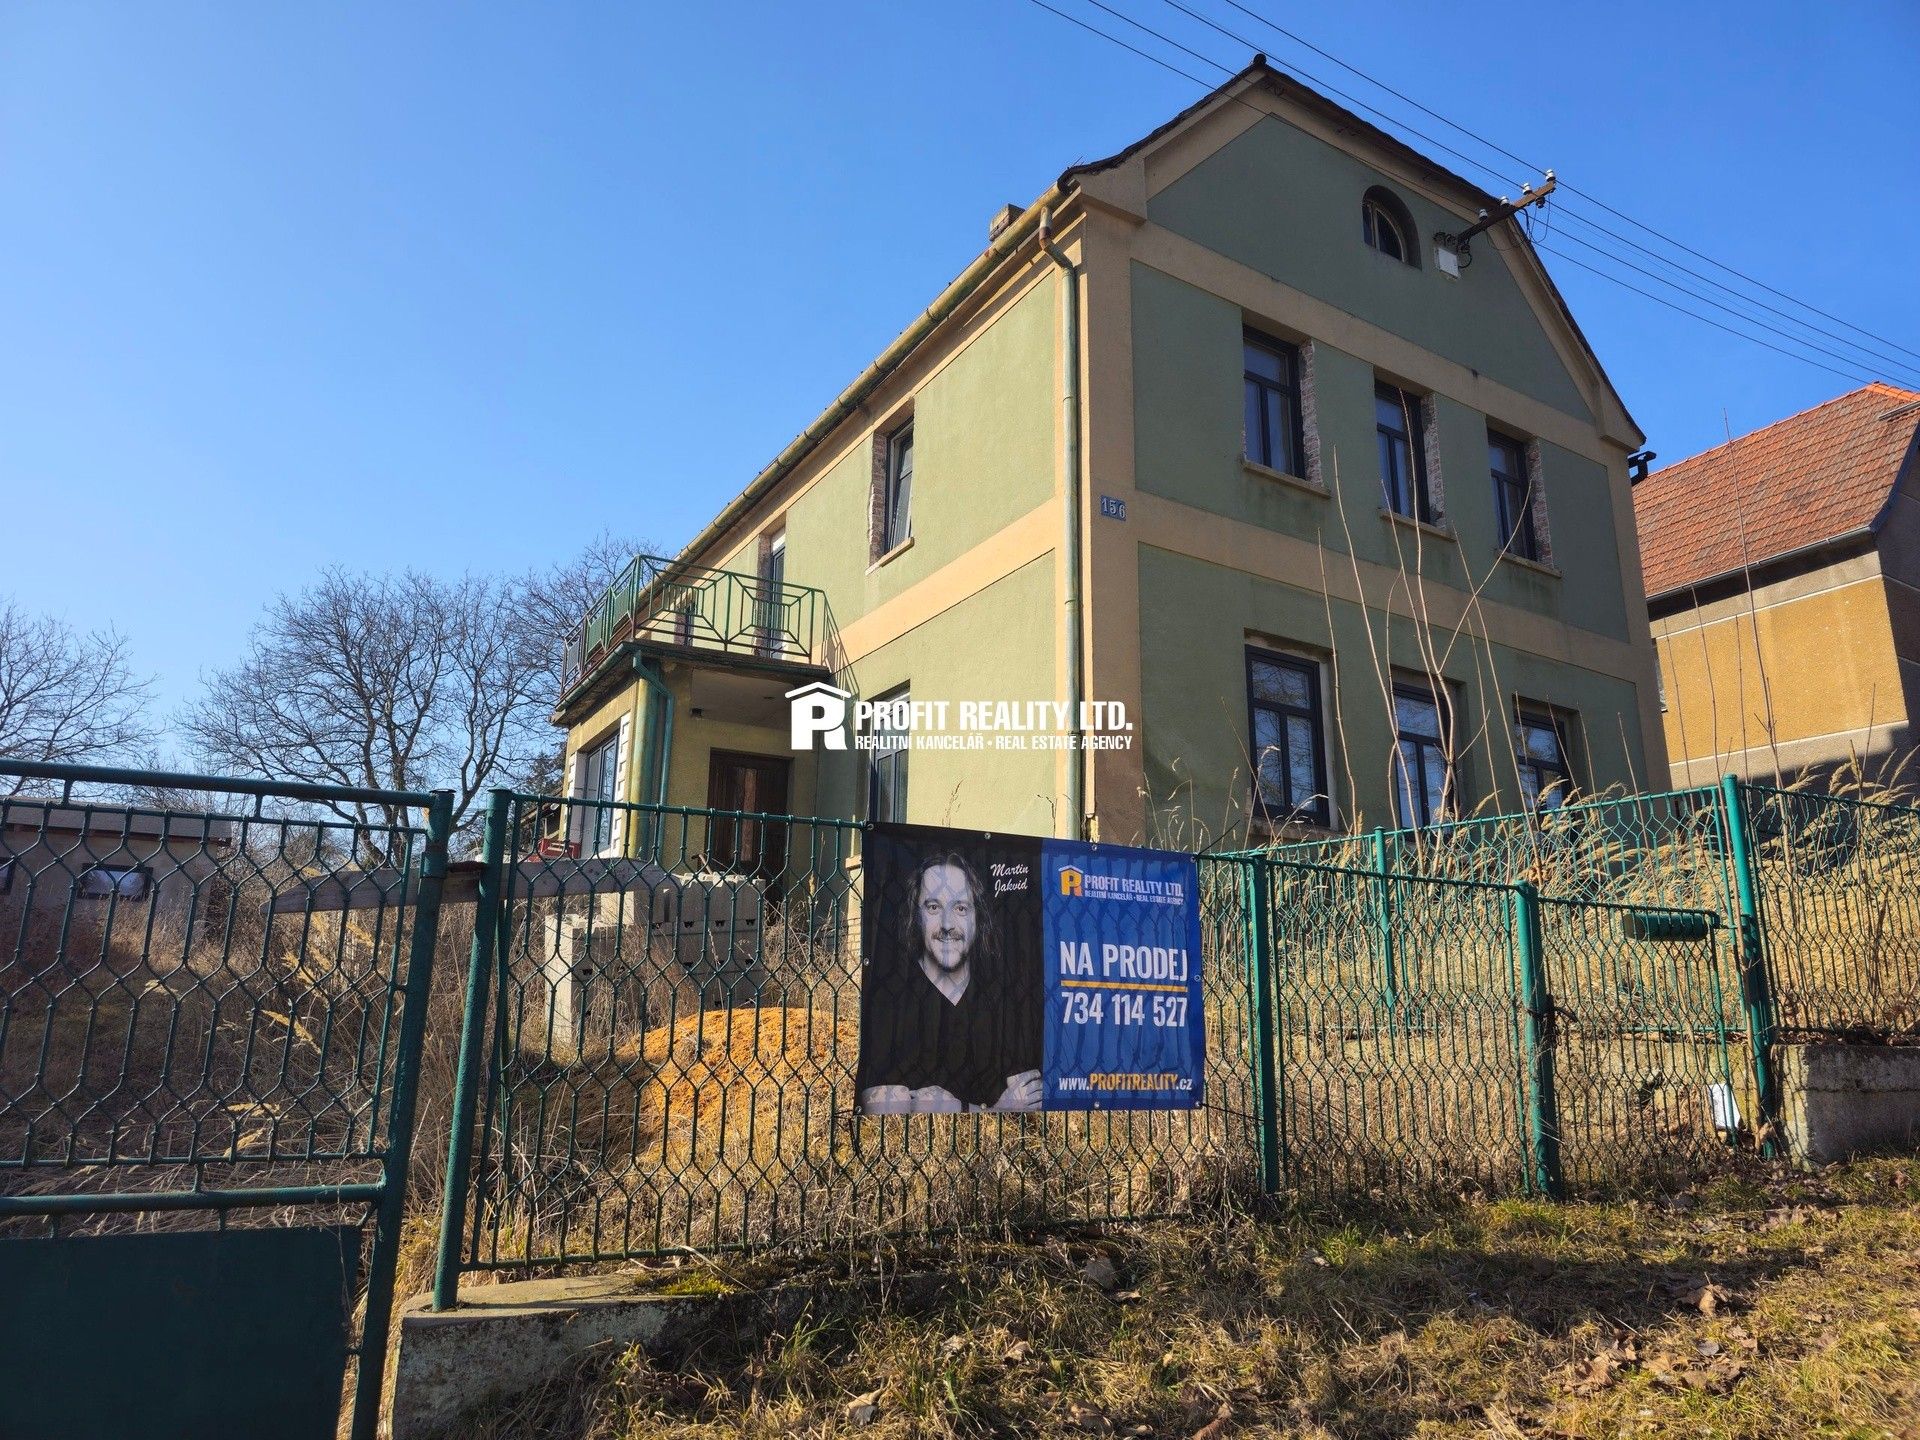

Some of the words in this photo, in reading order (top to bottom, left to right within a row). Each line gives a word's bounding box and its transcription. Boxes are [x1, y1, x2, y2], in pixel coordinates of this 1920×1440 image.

[1101, 497, 1126, 519] 156
[990, 863, 1029, 876] Martin
[1084, 874, 1119, 892] PROFIT
[1122, 878, 1162, 895] REALITY
[1165, 882, 1184, 897] LTD.
[1060, 941, 1094, 976] NA
[1103, 943, 1188, 981] PRODEJ
[1061, 992, 1103, 1025] 734
[1111, 994, 1145, 1026] 114
[1153, 996, 1188, 1027] 527
